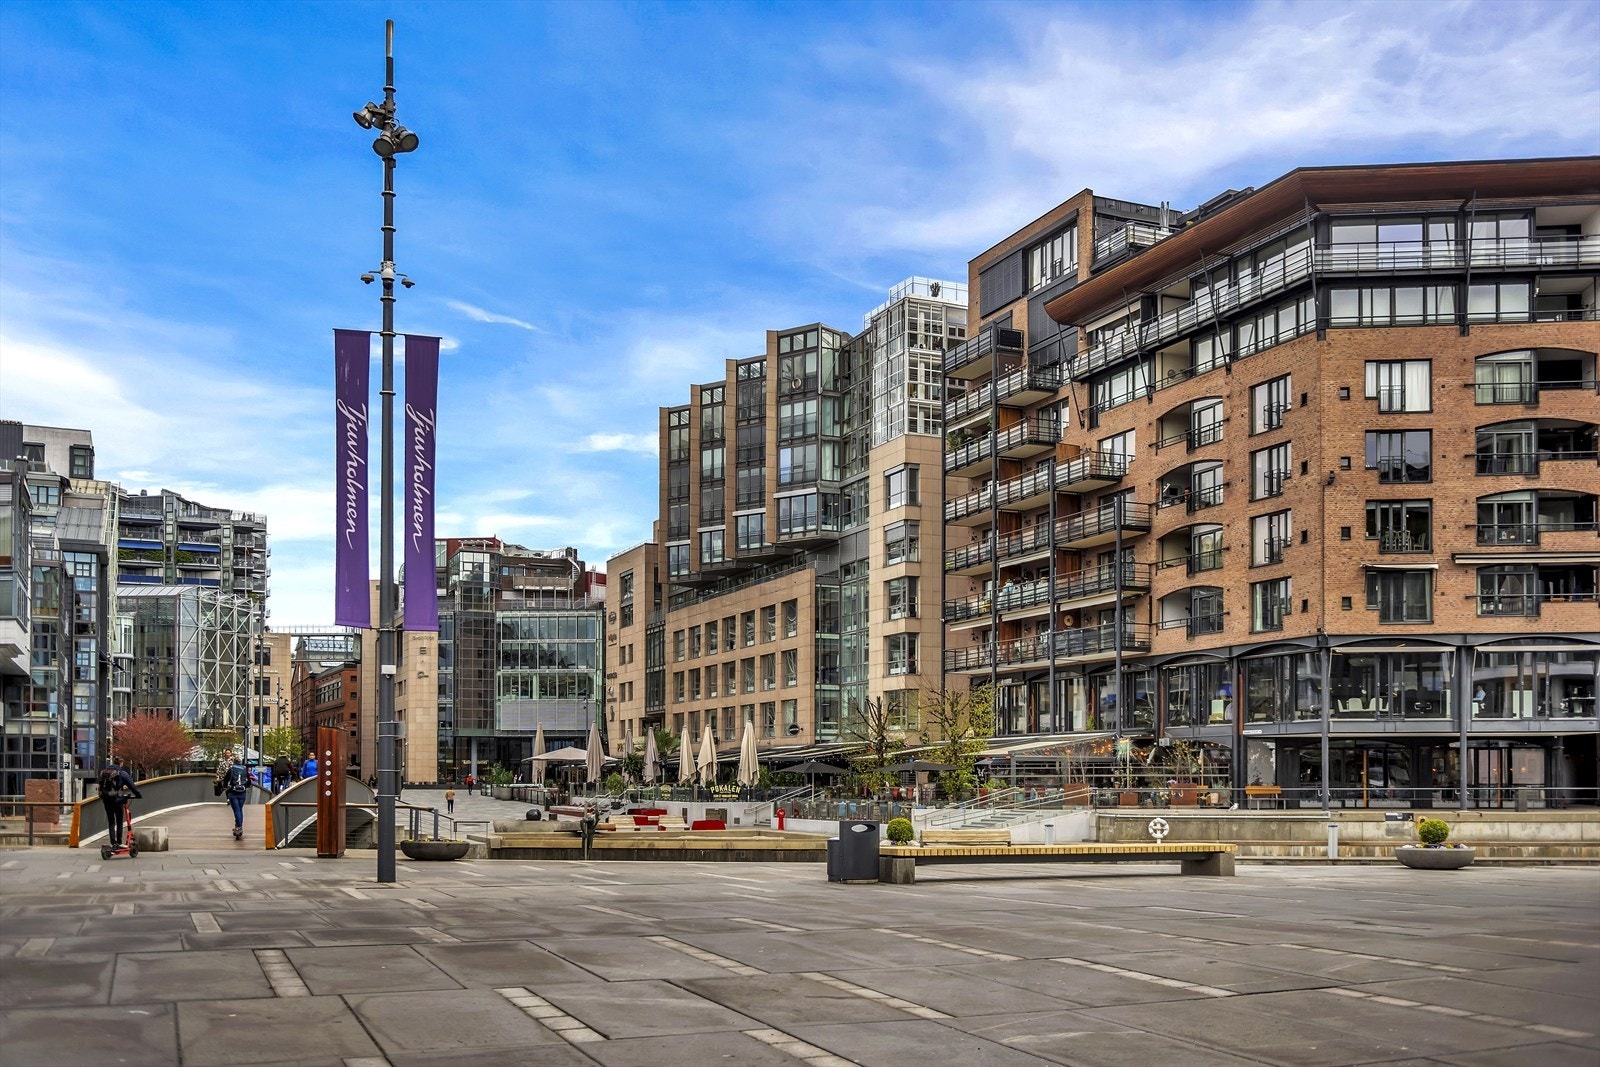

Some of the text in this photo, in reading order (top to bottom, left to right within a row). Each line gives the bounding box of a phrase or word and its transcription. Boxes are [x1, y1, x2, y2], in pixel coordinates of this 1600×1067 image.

[337, 398, 369, 550] Tjuvholmen
[405, 403, 435, 553] Tjuvholmen
[710, 784, 741, 794] POKALEN
